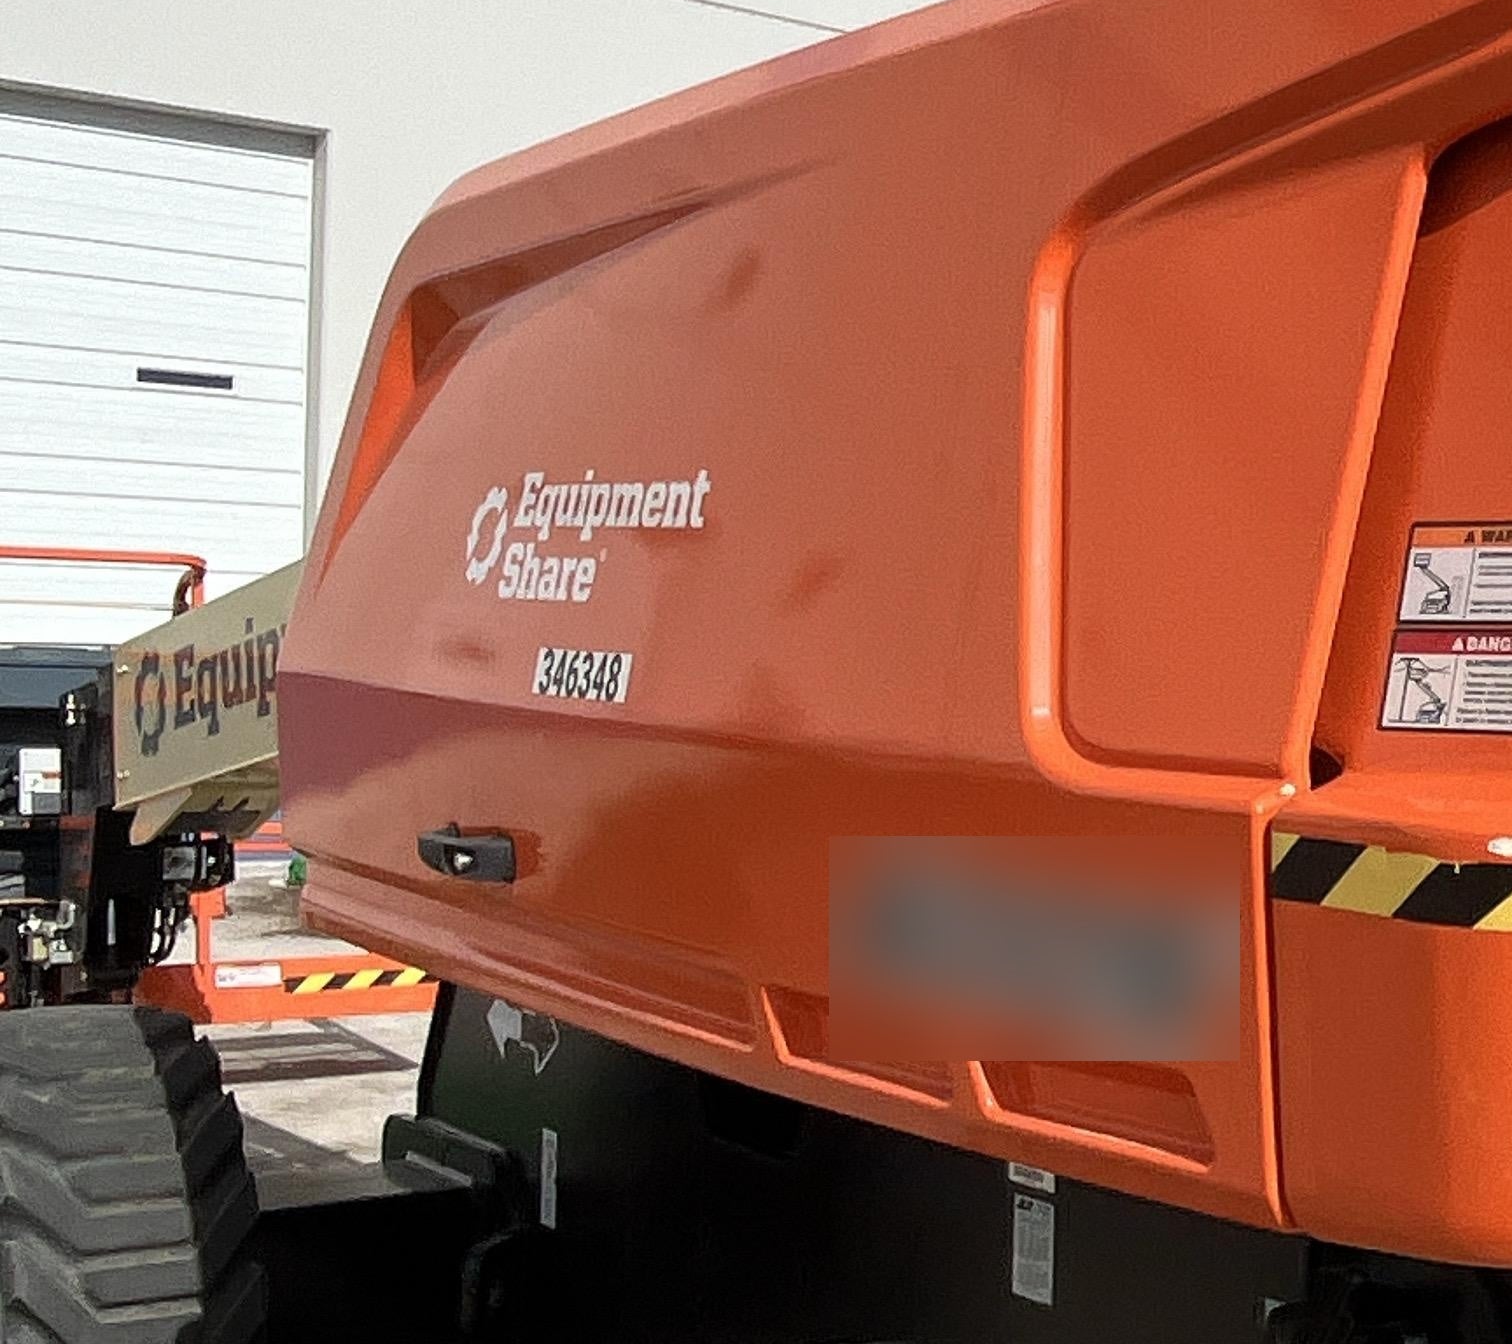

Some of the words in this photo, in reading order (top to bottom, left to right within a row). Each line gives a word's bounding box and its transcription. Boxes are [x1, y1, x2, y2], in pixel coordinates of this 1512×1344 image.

[513, 469, 711, 541] Equipment
[498, 542, 597, 602] Share
[174, 617, 287, 730] Equip
[538, 648, 623, 702] 346348
